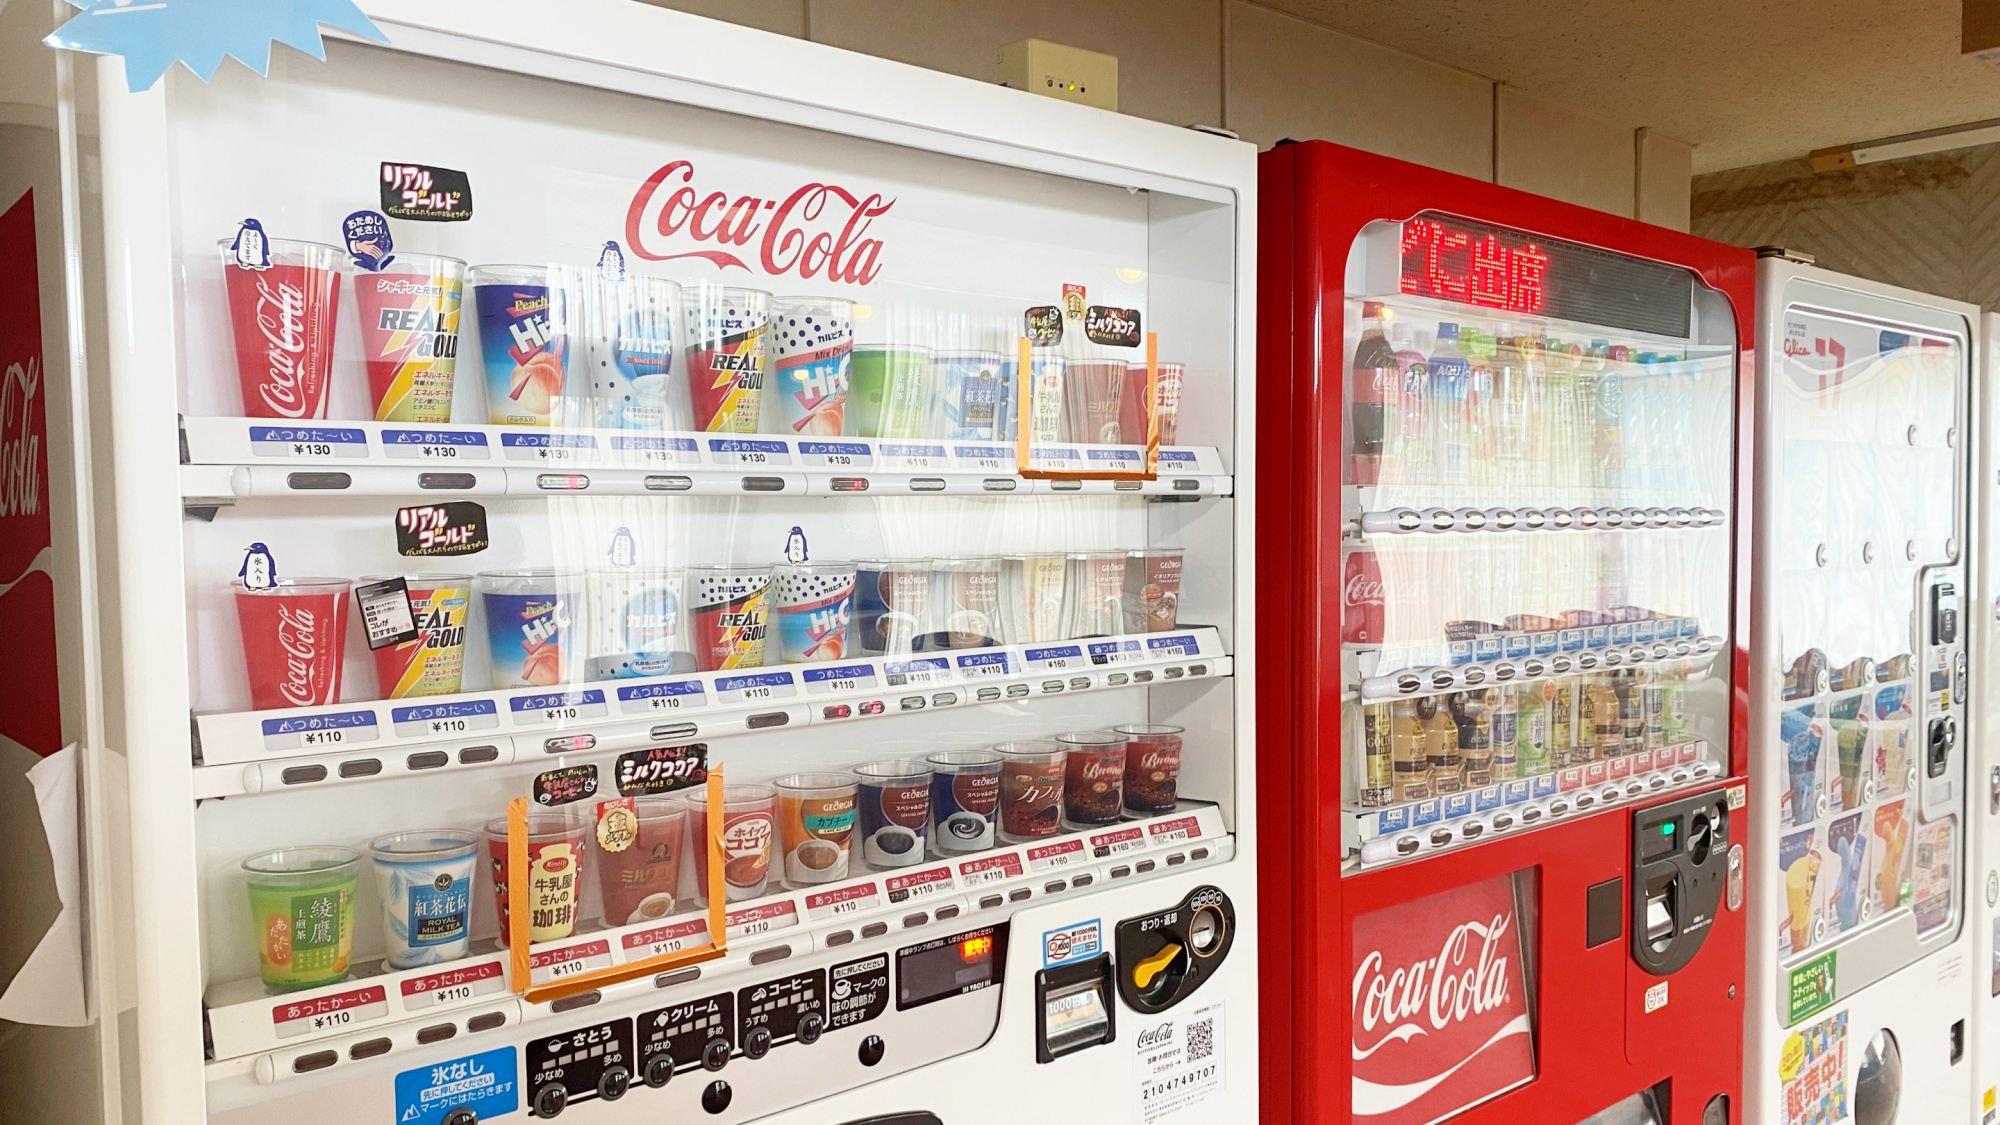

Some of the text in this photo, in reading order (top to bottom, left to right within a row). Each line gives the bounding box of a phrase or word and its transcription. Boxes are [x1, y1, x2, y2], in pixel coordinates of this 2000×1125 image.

[383, 164, 432, 190] リアル
[402, 191, 461, 210] ゴールド
[347, 215, 383, 230] おためし
[625, 160, 897, 286] Coca-Cola
[349, 225, 384, 239] ください
[515, 296, 549, 312] Peach
[379, 305, 447, 332] REAL
[817, 330, 844, 344] カルピス
[257, 273, 306, 417] Coca-Cola
[1783, 338, 1811, 358] Glico
[710, 352, 758, 371] REAL
[815, 350, 830, 360] Mix
[281, 430, 353, 441] つめた〜い
[411, 432, 476, 444] つめた〜い
[294, 444, 331, 456] ¥130
[423, 446, 456, 457] ¥130
[539, 449, 569, 459] ¥130
[645, 451, 672, 461] ¥130
[741, 453, 766, 463] ¥130
[827, 455, 851, 465] ¥130
[980, 459, 999, 468] ¥110
[1110, 460, 1126, 469] ¥110
[1167, 461, 1183, 469] ¥110
[401, 507, 448, 533] リアル
[419, 524, 476, 548] ゴールド
[252, 556, 263, 584] 氷入り
[717, 585, 747, 594] カルピス
[823, 583, 844, 594] カルピス
[369, 618, 389, 630] コレが
[718, 609, 761, 627] REAL
[371, 627, 398, 639] おすすめ
[426, 625, 465, 649] GOLD
[278, 603, 316, 706] Coca-Cola
[1167, 647, 1183, 656] ¥160
[981, 666, 1000, 675] ¥110
[1048, 660, 1066, 668] ¥160
[910, 673, 930, 682] ¥110
[642, 684, 695, 697] つめた〜い
[832, 680, 855, 690] ¥110
[744, 688, 770, 698] ¥110
[652, 698, 679, 708] ¥110
[420, 704, 486, 718] つめた〜い
[546, 708, 576, 720] ¥110
[295, 714, 365, 730] つめた〜い
[432, 720, 465, 732] ¥110
[306, 731, 342, 745] ¥110
[621, 757, 700, 784] ミルクココア
[971, 777, 999, 787] GEORGIA
[901, 788, 929, 799] GEORGIA
[823, 798, 853, 812] GEORGIA
[734, 825, 768, 838] ホイップ
[1169, 831, 1186, 840] ¥160
[1034, 843, 1076, 857] あったか〜い
[1112, 843, 1129, 853] ¥160
[1049, 856, 1068, 866] ¥160
[534, 873, 573, 893] 牛乳屋
[901, 871, 947, 887] あったか〜い
[983, 871, 1003, 881] ¥110
[815, 887, 868, 906] あったか〜い
[912, 885, 933, 896] ¥110
[413, 892, 467, 917] 紅茶花伝
[539, 893, 569, 905] さんの
[833, 901, 856, 914] ¥110
[309, 897, 336, 945] 綾鷹
[427, 916, 457, 927] ROYAL
[532, 905, 572, 928] 珈琲
[1141, 911, 1178, 932] おつり・返却
[295, 908, 307, 941] 上煎茶
[422, 920, 461, 934] MILK TEA
[744, 922, 768, 934] ¥110
[632, 924, 696, 945] あったか〜い
[1071, 934, 1098, 944] 使えません
[654, 941, 681, 954] ¥110
[553, 962, 583, 976] ¥110
[835, 959, 884, 978] 先に押してください
[414, 967, 490, 991] あったか〜い
[853, 976, 886, 992] マークの
[1352, 912, 1512, 1060] Coca-Cola
[437, 987, 470, 1001] ¥110
[768, 978, 814, 997] コーヒー
[1792, 980, 1817, 1000] スティックを
[287, 992, 372, 1018] あったか〜い
[832, 991, 877, 1013] 味の調節が
[670, 1000, 719, 1022] クリーム
[832, 1009, 867, 1027] できます
[314, 1012, 350, 1029] ¥110
[745, 1014, 769, 1027] うすめ
[572, 1026, 613, 1046] さとう
[706, 1025, 724, 1038] 多め
[1137, 1020, 1174, 1049] Coca-Cola
[644, 1039, 671, 1056] 少なめ
[603, 1053, 622, 1066] 多め
[431, 1059, 485, 1085] 氷なし
[1152, 1063, 1174, 1074] こちらから
[534, 1069, 565, 1085] 少なめ
[1786, 1040, 1845, 1122] 販売中!
[422, 1075, 494, 1100] 先に押してください
[420, 1082, 513, 1112] マークにはたらきます
